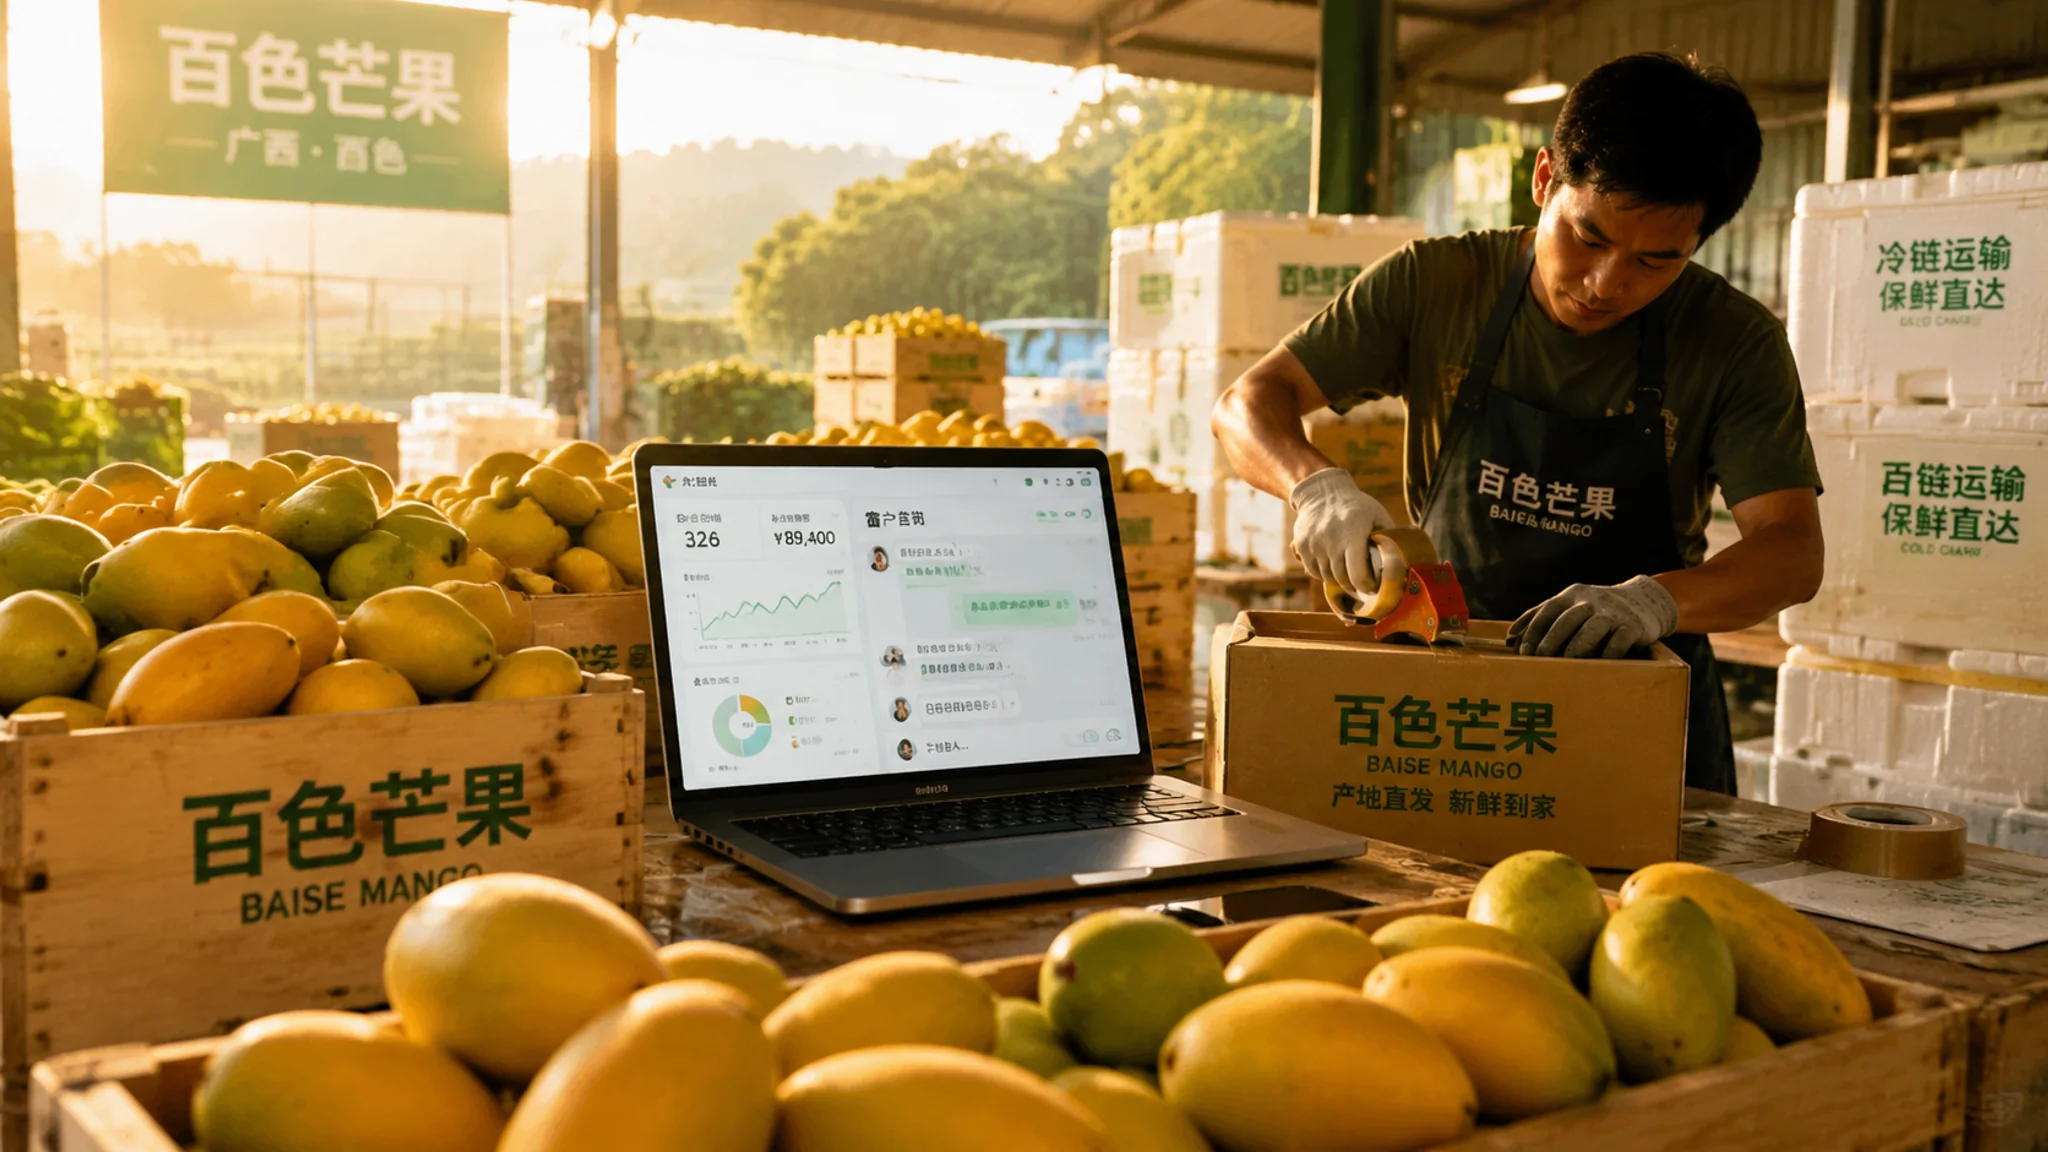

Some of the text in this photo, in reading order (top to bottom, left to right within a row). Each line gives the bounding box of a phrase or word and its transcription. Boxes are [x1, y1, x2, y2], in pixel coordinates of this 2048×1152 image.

[158, 24, 462, 126] 百色芒果
[1875, 234, 2012, 275] 冷链运输
[1879, 277, 2006, 313] 保鲜直达
[1477, 459, 1617, 521] 百色芒果
[1881, 461, 2026, 503] 百链运输
[685, 531, 720, 548] 326
[1881, 502, 2020, 544] 保鲜直达
[1334, 693, 1558, 756] 百色芒果
[1366, 754, 1523, 780] BAISE MANGO
[1331, 782, 1557, 819] 产地直发 新鲜到家
[182, 762, 533, 886] 百色芒果
[240, 881, 347, 925] BAISE
